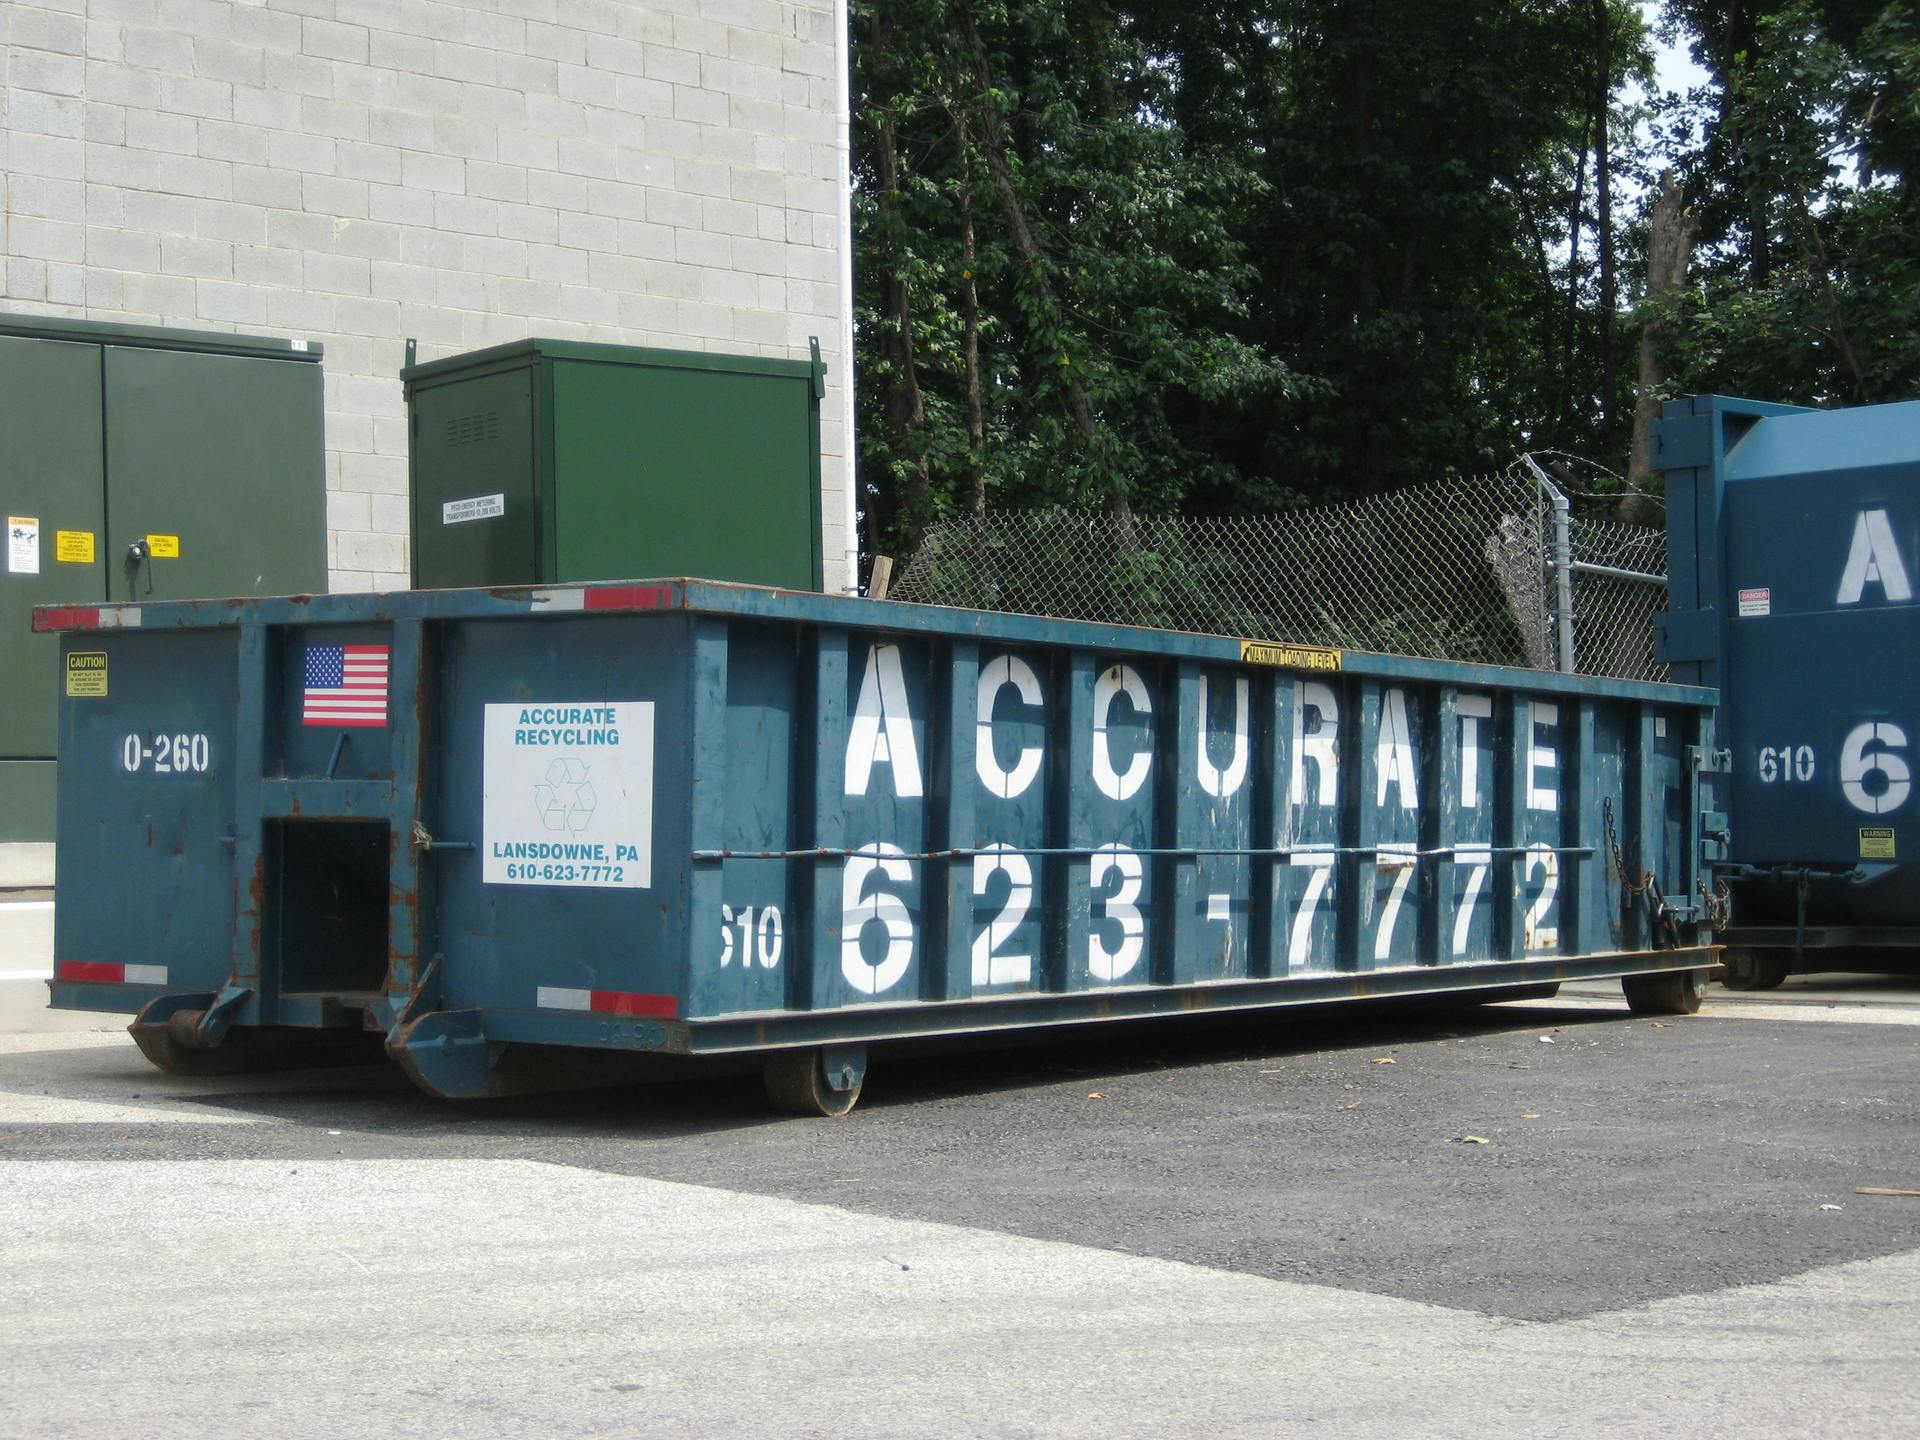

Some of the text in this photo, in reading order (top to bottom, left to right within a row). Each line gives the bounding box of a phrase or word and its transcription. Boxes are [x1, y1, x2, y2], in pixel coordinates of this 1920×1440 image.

[1836, 509, 1912, 605] A
[1741, 590, 1768, 601] DANGER
[70, 656, 105, 668] CAUTION
[1248, 646, 1333, 670] MAXIMUM LOADING LEVEL
[519, 708, 616, 725] ACCURATE
[844, 643, 1558, 811] ACCURATE
[515, 729, 620, 746] RECYCLING
[1759, 722, 1911, 814] 610 6
[1862, 830, 1892, 838] WARNING
[493, 842, 639, 863] LANSDOWNE, PA
[507, 864, 624, 882] 610-623-7772
[841, 842, 1559, 995] 623-7772
